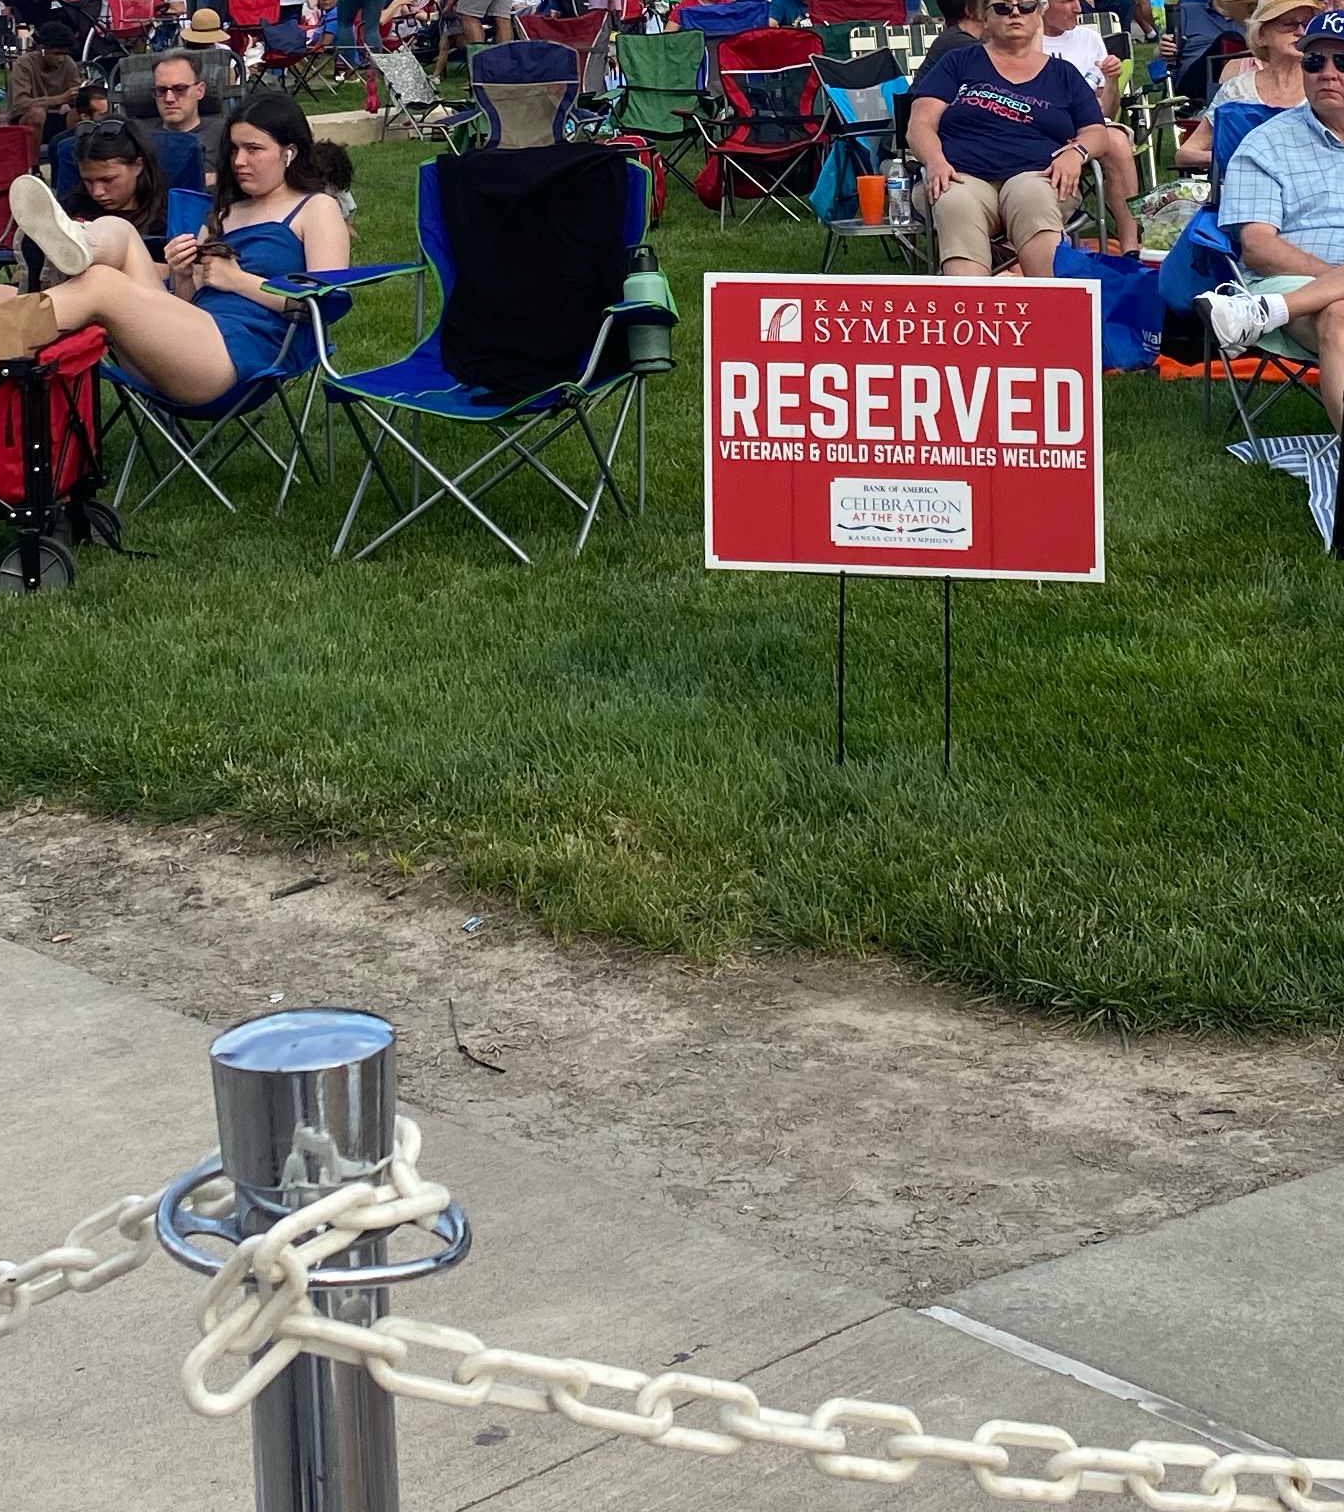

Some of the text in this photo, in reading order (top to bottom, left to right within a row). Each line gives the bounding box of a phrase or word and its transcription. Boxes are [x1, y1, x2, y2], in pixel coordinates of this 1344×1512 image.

[1321, 12, 1344, 33] KC
[966, 90, 1032, 114] INSPIRED
[970, 82, 1051, 110] CONFIDENT
[814, 299, 1031, 316] KANSAS CITY
[814, 317, 1032, 348] SYMPHONY
[720, 361, 1084, 446] RESERVED
[719, 440, 1088, 470] VETERANS & GOLD STAR FAMILIES WELCOME
[863, 484, 939, 494] BANK OF AMERICA
[840, 496, 962, 514] CELEBRATION
[852, 512, 950, 525] AT THE STATION
[906, 537, 955, 545] SYMPHONY
